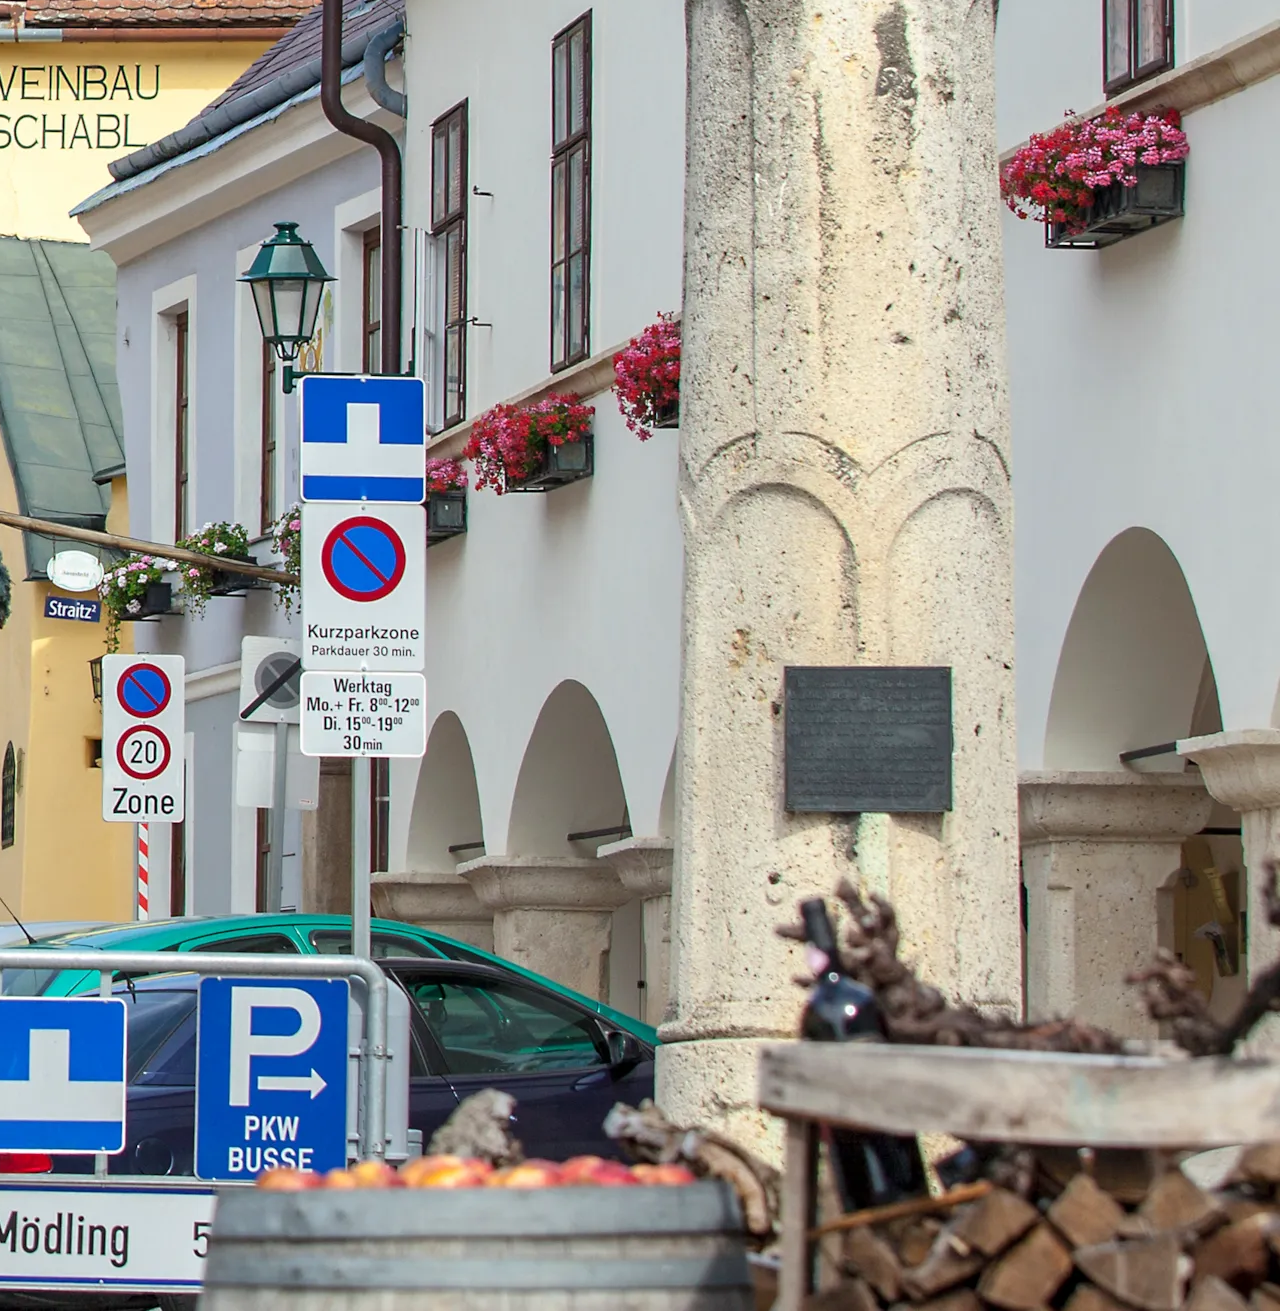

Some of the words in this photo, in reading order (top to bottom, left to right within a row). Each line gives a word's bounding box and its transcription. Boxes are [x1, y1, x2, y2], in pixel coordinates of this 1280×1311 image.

[307, 624, 420, 642] Kurzparkzone
[311, 645, 370, 657] Parkdauer
[373, 646, 389, 657] 30
[391, 647, 416, 657] min.
[333, 678, 392, 697] Werktag
[348, 698, 364, 712] Fr.
[323, 716, 341, 731] Di.
[130, 740, 157, 764] 20
[112, 787, 175, 815] Zone
[228, 986, 322, 1107] P
[244, 1116, 300, 1142] PKW
[228, 1148, 314, 1173] BUSSE
